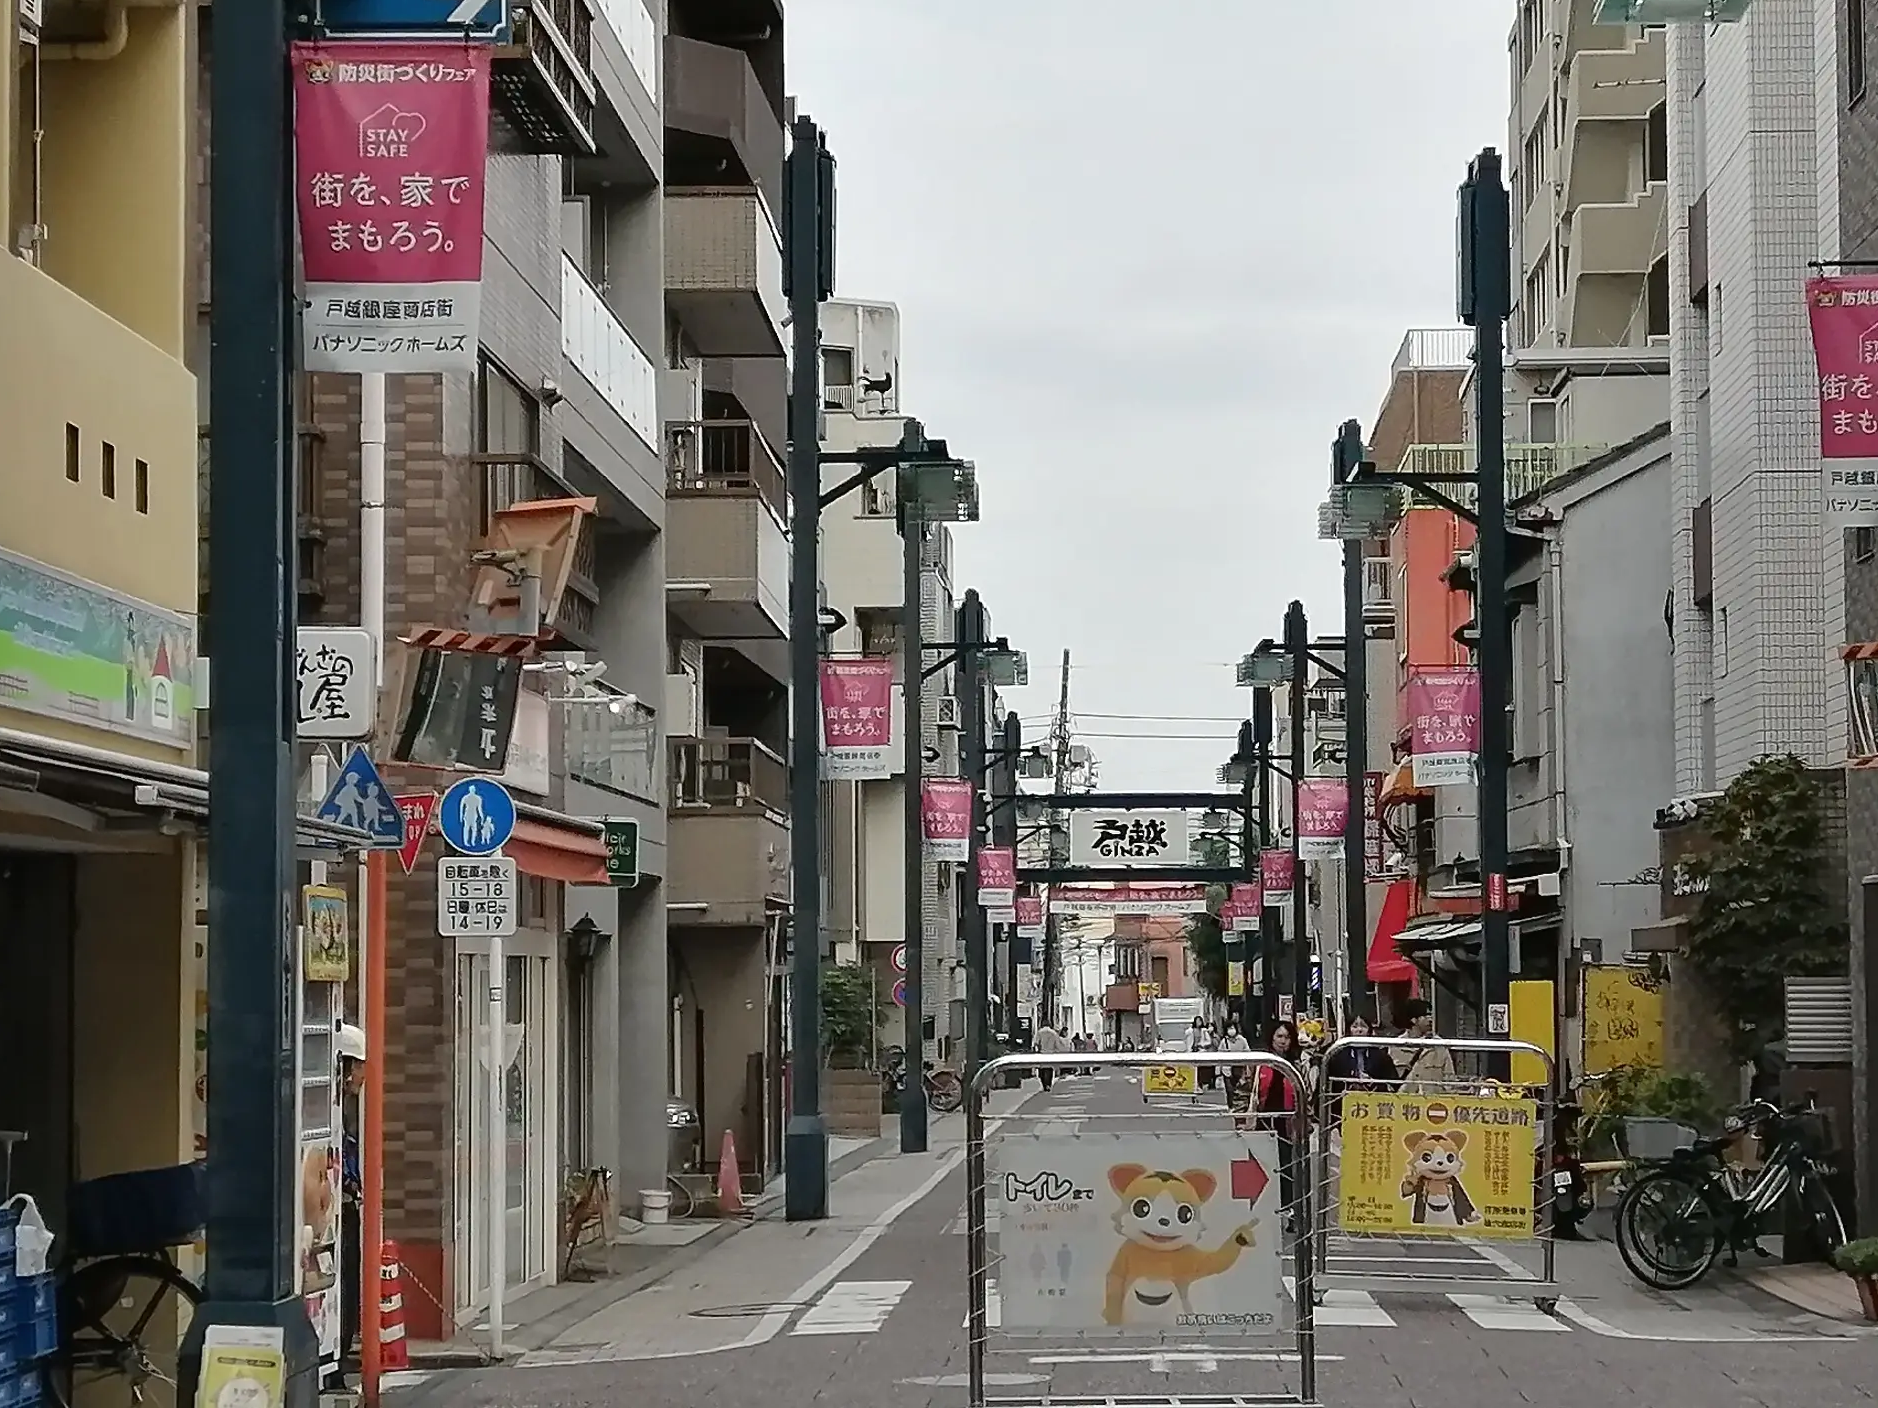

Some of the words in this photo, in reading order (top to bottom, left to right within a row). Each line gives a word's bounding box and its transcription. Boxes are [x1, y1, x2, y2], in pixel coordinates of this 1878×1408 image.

[337, 63, 478, 86] 防災街づくりフェア
[366, 128, 410, 142] STAY
[366, 144, 410, 158] SAFE
[310, 173, 471, 210] 街を、家で
[328, 219, 455, 255] まもろう。
[324, 297, 454, 321] 戸越銀座商店街
[402, 801, 426, 821] まれ
[1091, 819, 1169, 849] 戸越
[1100, 841, 1160, 857] GINZA
[1350, 1101, 1421, 1122] お買物
